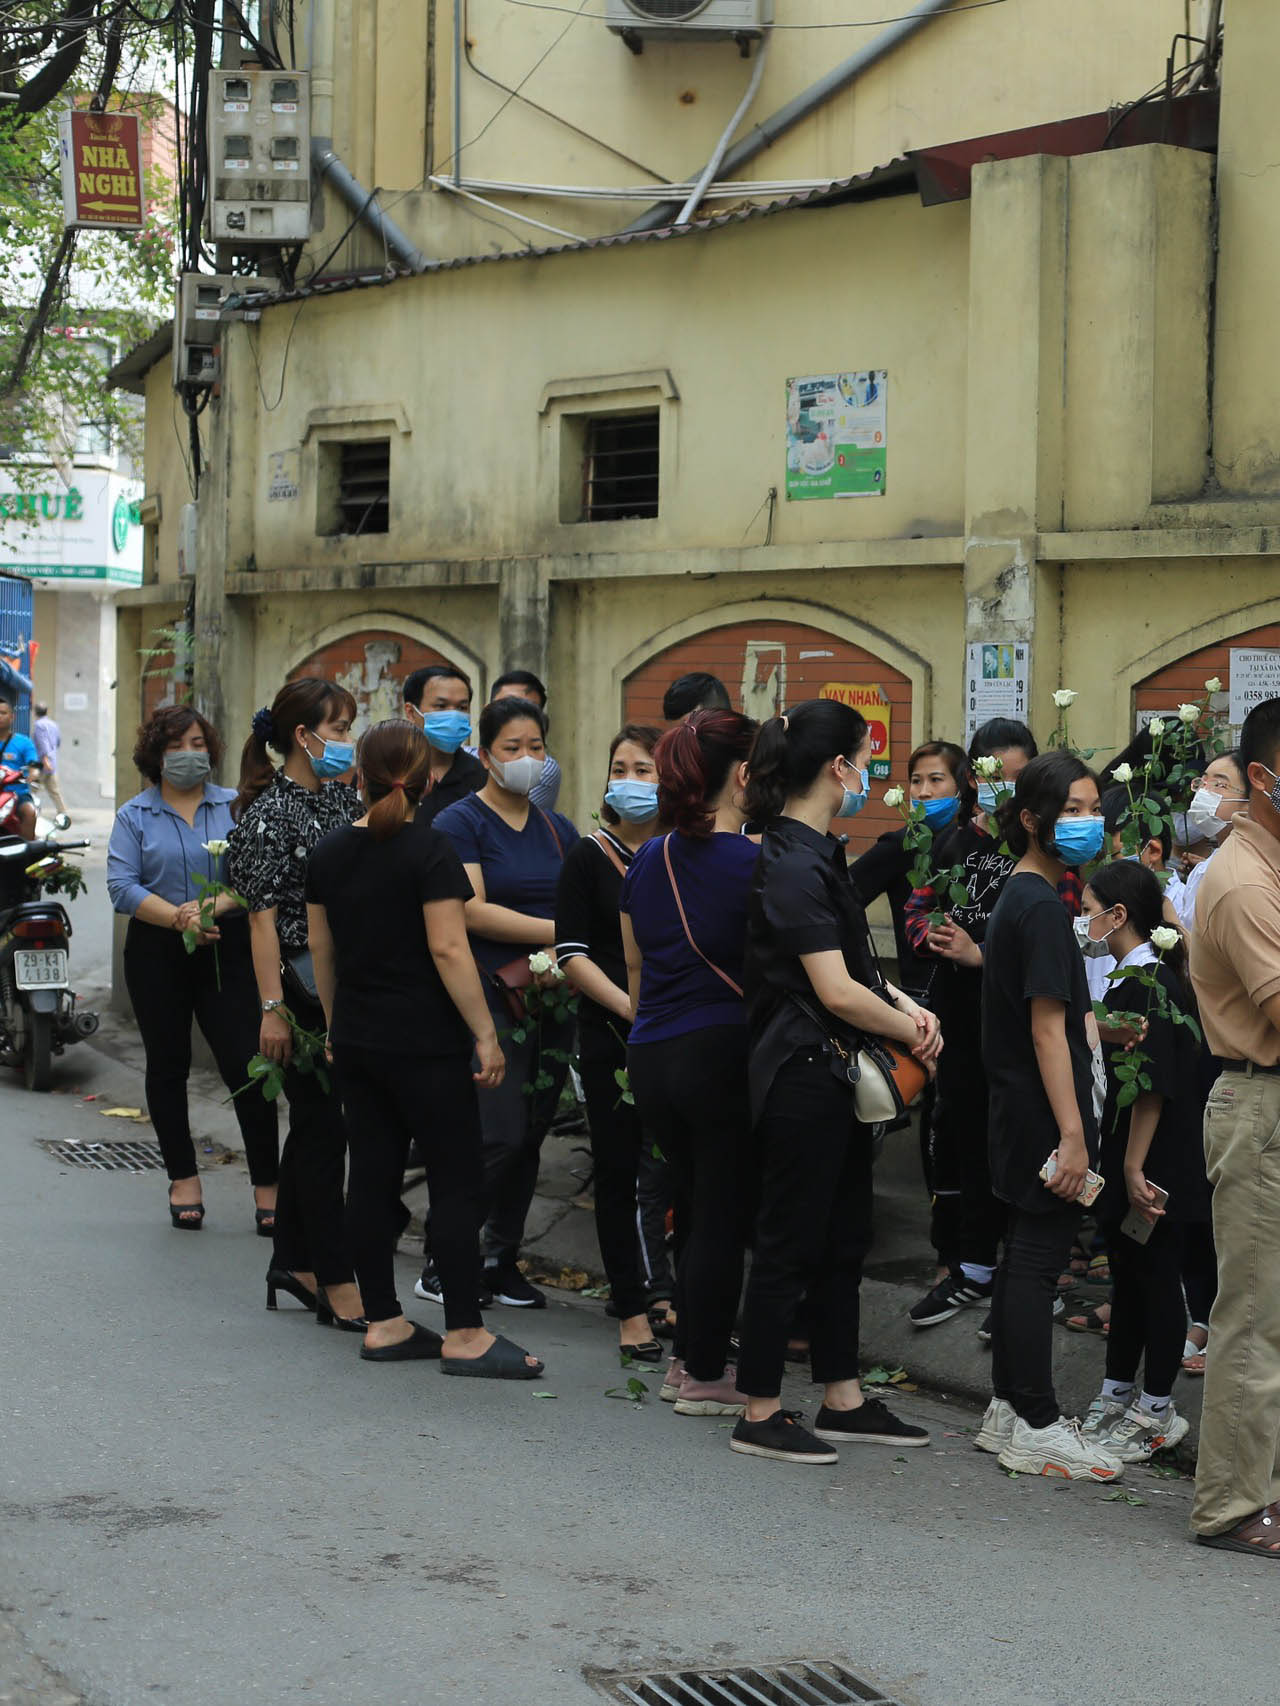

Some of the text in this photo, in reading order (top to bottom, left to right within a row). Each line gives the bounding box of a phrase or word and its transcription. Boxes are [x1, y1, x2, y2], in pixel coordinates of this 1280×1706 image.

[82, 143, 130, 170] NHÀ
[78, 170, 137, 197] NGHỈ
[824, 690, 845, 702] VAY
[1243, 690, 1263, 701] 0358
